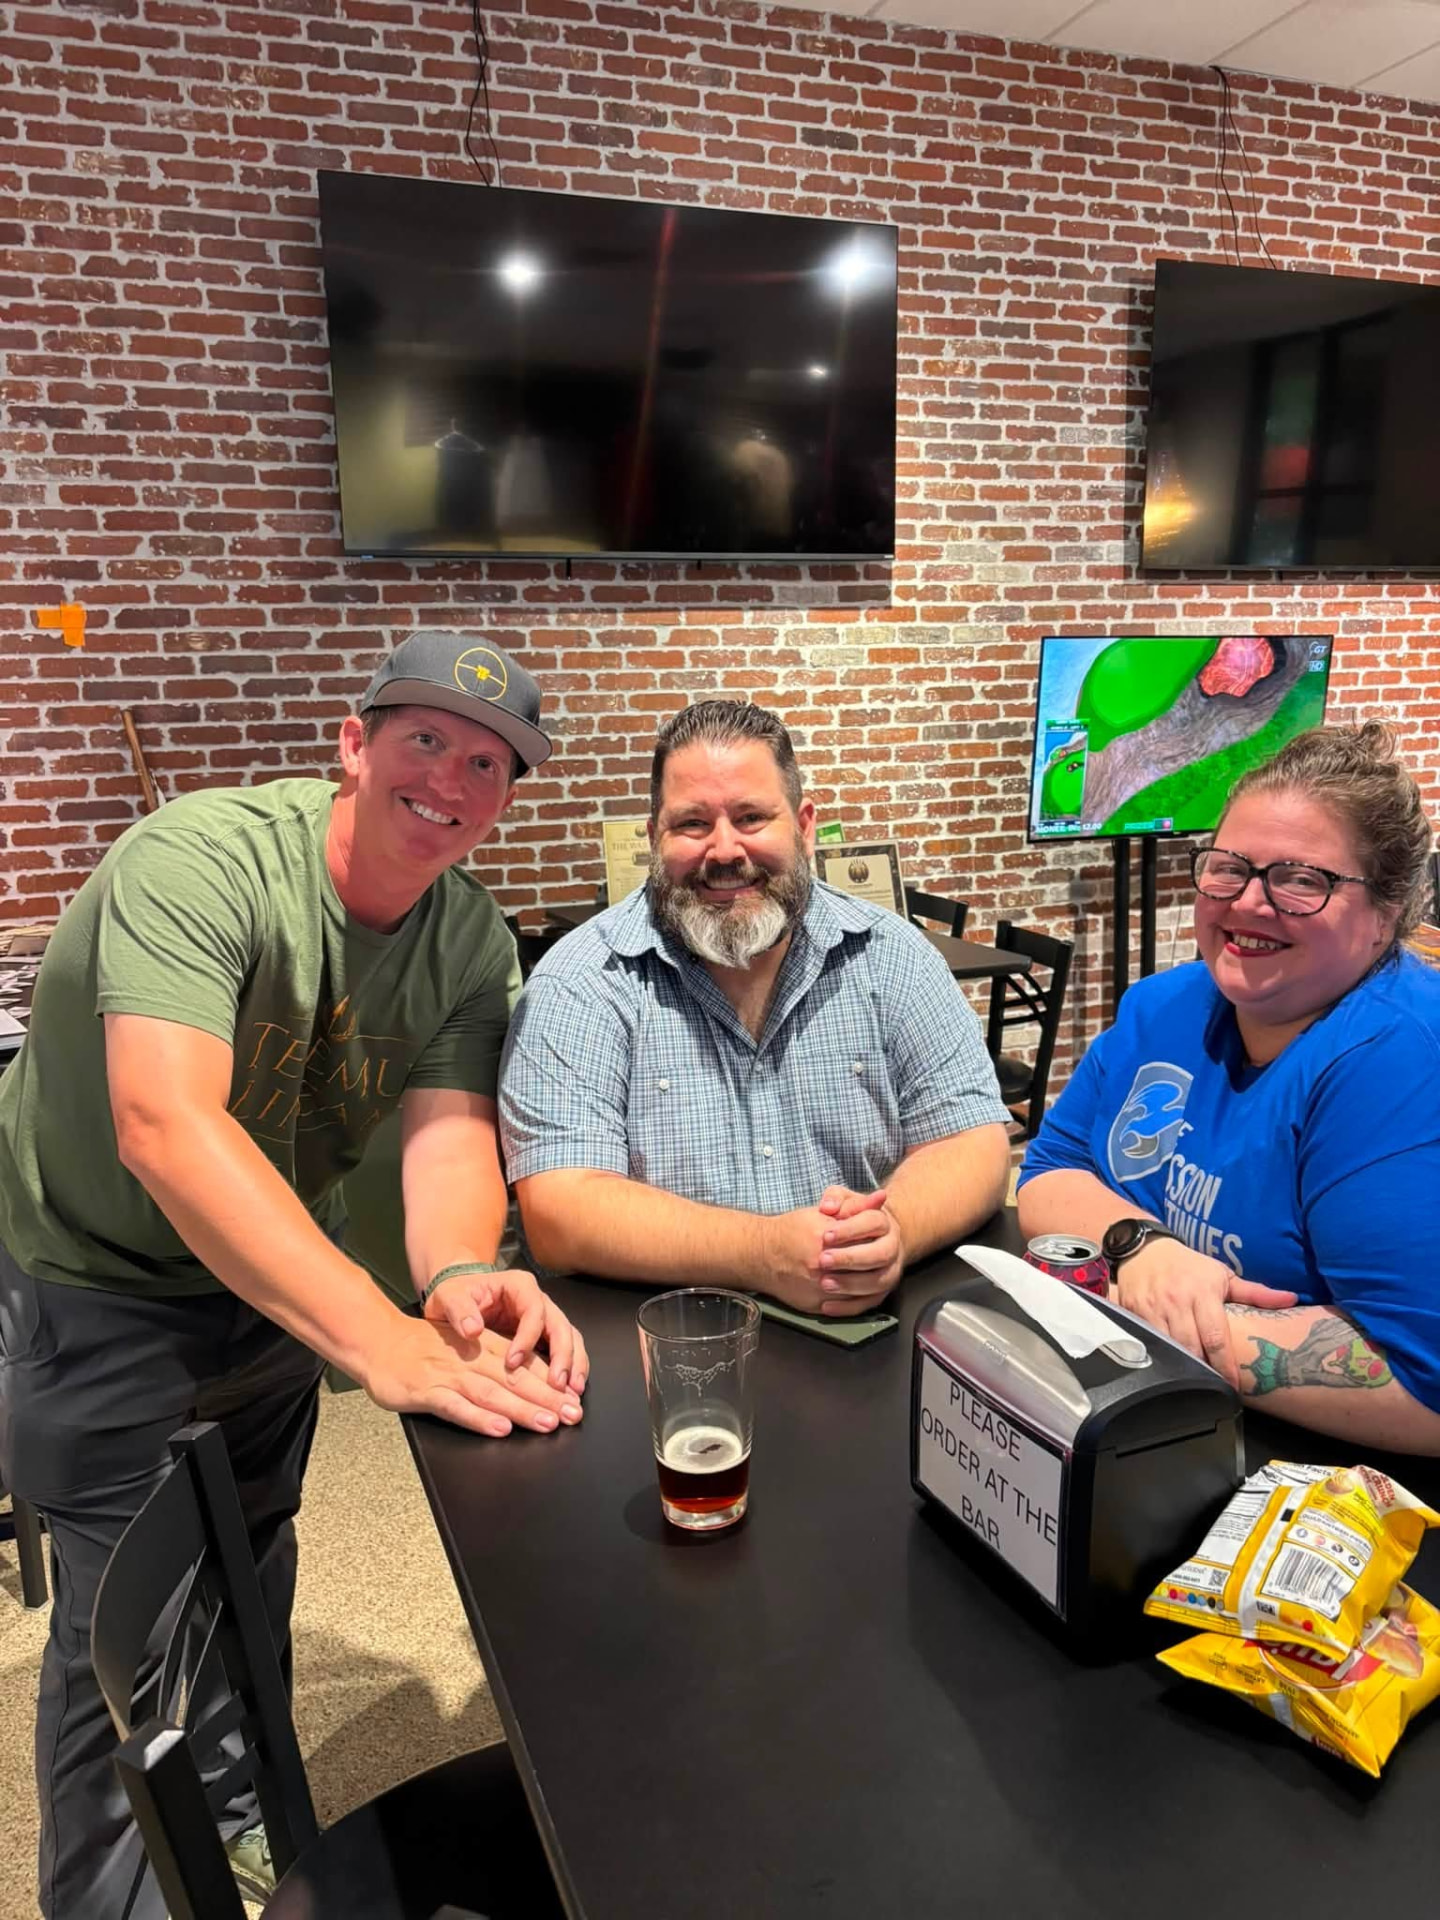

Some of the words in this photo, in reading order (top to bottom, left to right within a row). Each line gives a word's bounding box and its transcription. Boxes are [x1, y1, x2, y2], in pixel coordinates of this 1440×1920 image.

[949, 1381, 1021, 1462] PLEASE
[921, 1407, 980, 1482] ORDER
[985, 1468, 1009, 1503] AT
[1013, 1487, 1058, 1546] THE
[962, 1495, 1000, 1549] BAR
